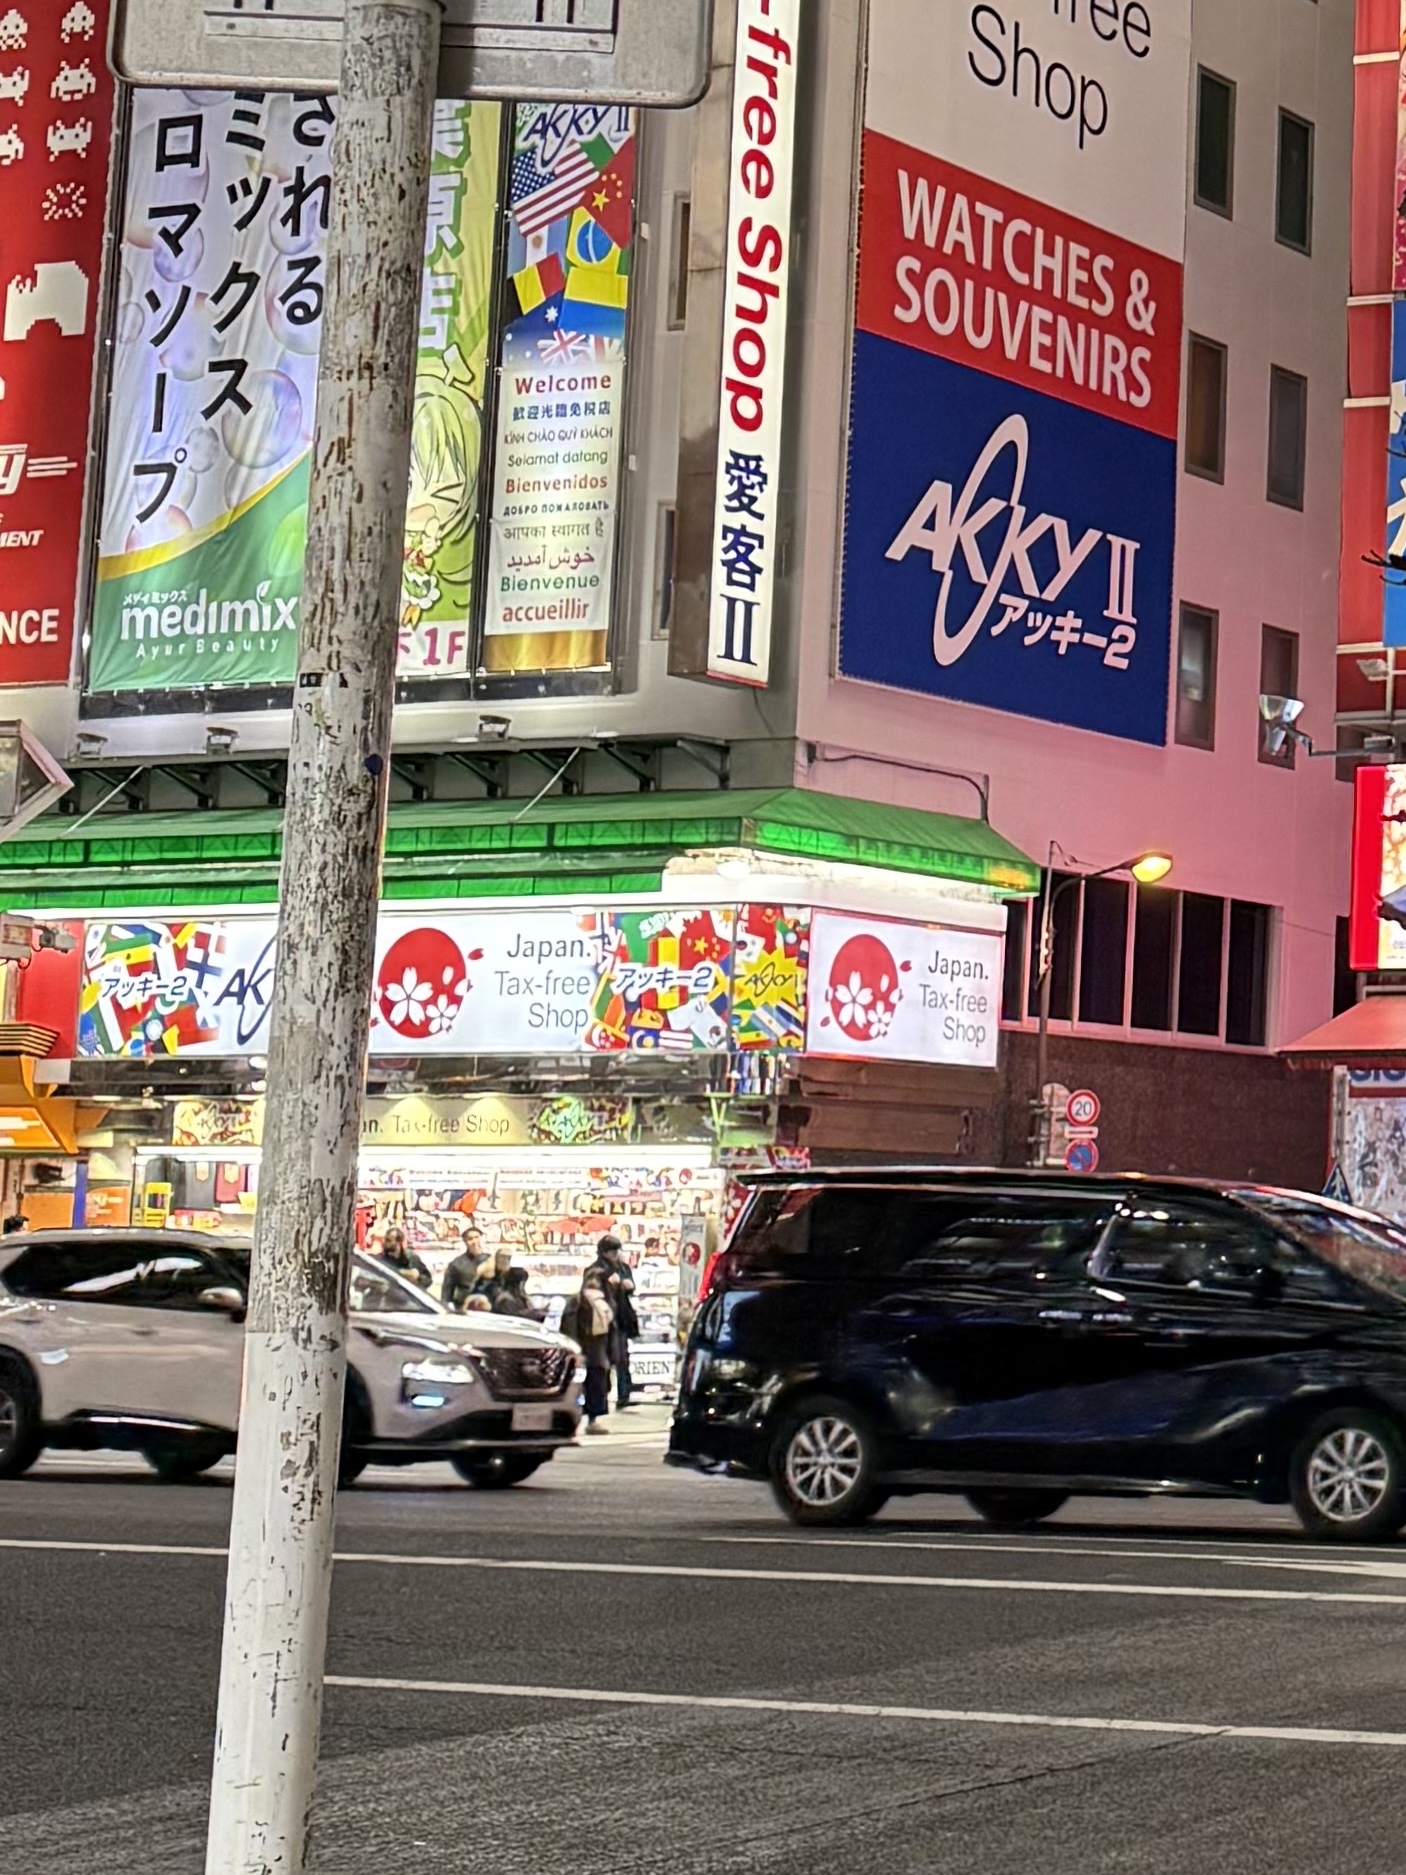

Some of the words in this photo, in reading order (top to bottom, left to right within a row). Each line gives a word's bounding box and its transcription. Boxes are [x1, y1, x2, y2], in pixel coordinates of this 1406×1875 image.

[966, 2, 1108, 149] Shop
[897, 167, 1117, 317] WATCHES
[1126, 267, 1158, 338] &
[726, 222, 784, 433] Shop
[893, 253, 1154, 409] SOUVENIRS
[514, 373, 612, 396] Welcome
[505, 474, 608, 494] Bienvenidos
[500, 574, 600, 593] Bienvenue
[120, 580, 298, 641] medimix
[502, 597, 589, 624] accueillir
[196, 637, 280, 656] Beauty
[506, 933, 592, 967] Japan.
[928, 950, 989, 982] Japan.
[494, 969, 591, 996] Tax-free
[919, 983, 988, 1014] Tax-free
[527, 1002, 590, 1035] Shop
[942, 1016, 987, 1048] Shop
[1074, 1101, 1093, 1116] 20
[465, 1114, 511, 1138] Shop
